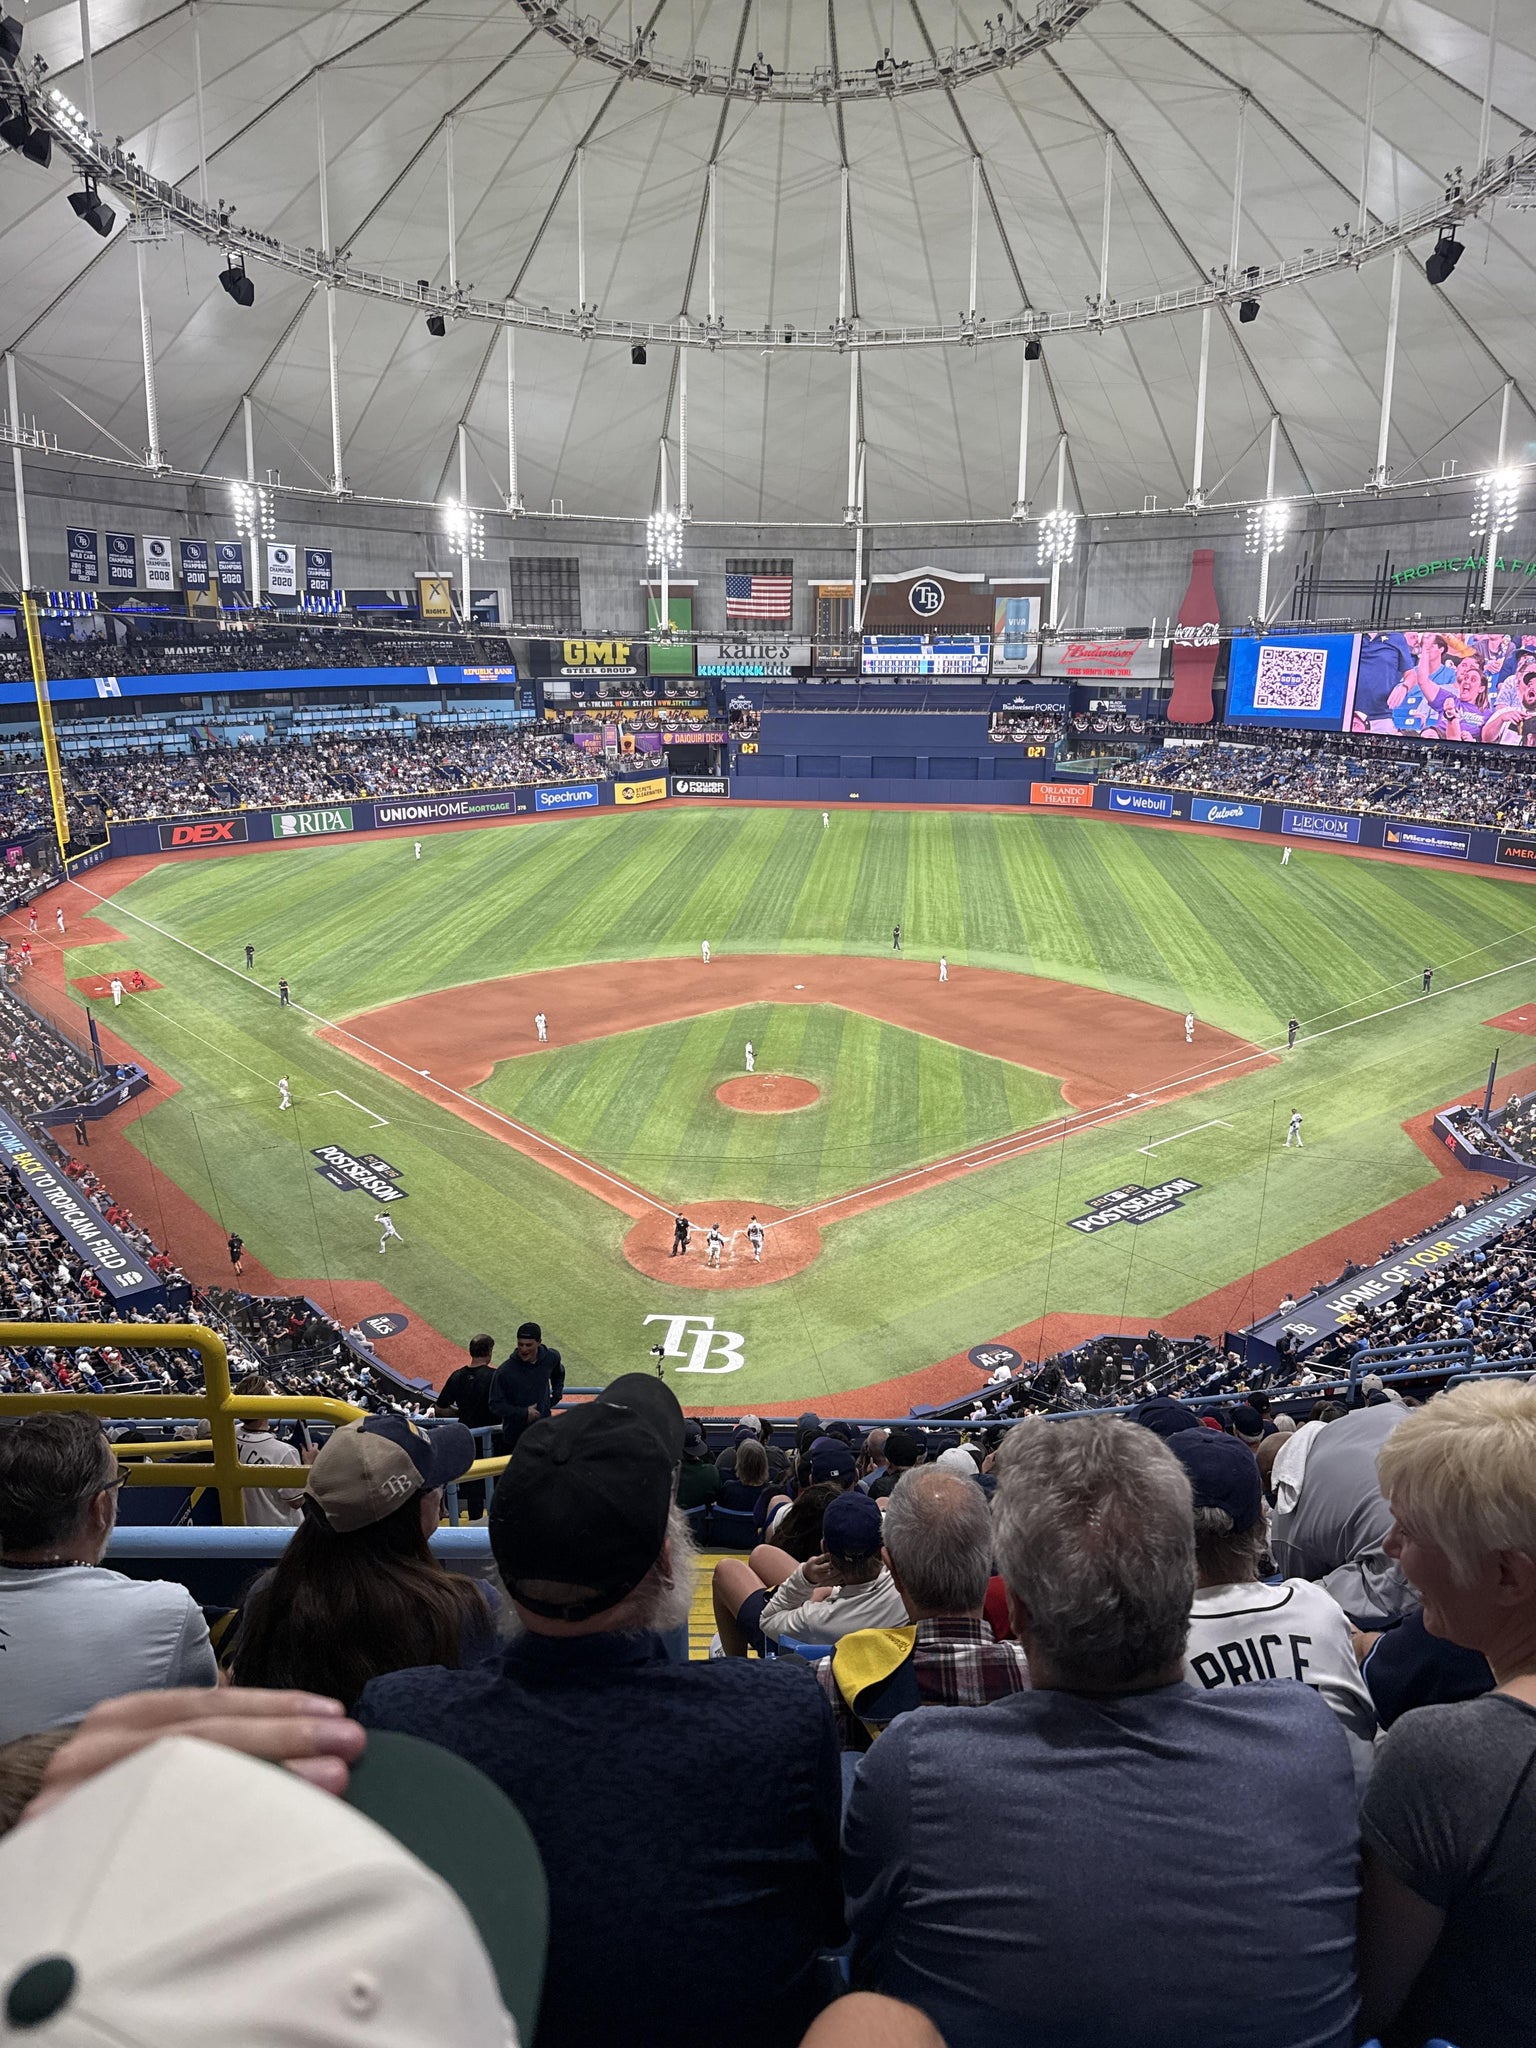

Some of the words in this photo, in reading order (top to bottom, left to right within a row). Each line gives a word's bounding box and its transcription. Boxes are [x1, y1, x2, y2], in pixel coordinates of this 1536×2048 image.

[112, 567, 133, 578] 2008
[149, 570, 170, 581] 2008
[187, 573, 206, 583] 2010
[1391, 556, 1506, 585] TROPICANA
[222, 574, 242, 584] 2020
[272, 576, 292, 587] 2020
[310, 580, 329, 590] 2021
[915, 586, 939, 609] TB
[1008, 618, 1026, 626] VIVA
[563, 638, 632, 665] GMF
[718, 645, 792, 660] kanes
[1068, 644, 1134, 658] Budweiser
[1035, 704, 1066, 712] PORCH
[674, 734, 705, 744] DAIQUIRI
[706, 734, 724, 743] DECK
[1028, 746, 1046, 758] 0:27
[1040, 785, 1086, 796] ORLANDO
[540, 791, 588, 806] Spectrum
[1044, 795, 1080, 804] HEALTH
[1132, 796, 1166, 811] Webull
[468, 802, 510, 813] MORTGAGE
[1207, 806, 1244, 821] Culver's
[298, 810, 347, 834] RIPA
[172, 821, 235, 846] DEX
[1402, 833, 1466, 848] MicroLumen
[12, 1152, 46, 1176] BACK
[32, 1174, 57, 1188] TO
[314, 1146, 404, 1202] POSTSEASON
[1071, 1178, 1198, 1232] POSTSEASON
[42, 1186, 97, 1241] TROPICANA
[89, 1238, 127, 1270] FIELD
[1326, 1279, 1390, 1314] HOME
[1381, 1264, 1413, 1284] OF
[1403, 1241, 1460, 1268] YOUR
[1446, 1215, 1508, 1244] TAMPA
[1495, 1198, 1532, 1217] BAY
[1281, 1322, 1318, 1336] TB
[642, 1314, 745, 1374] TB
[980, 1350, 1014, 1366] ALCS
[381, 1474, 412, 1499] TB
[1190, 1634, 1318, 1691] PRICE
